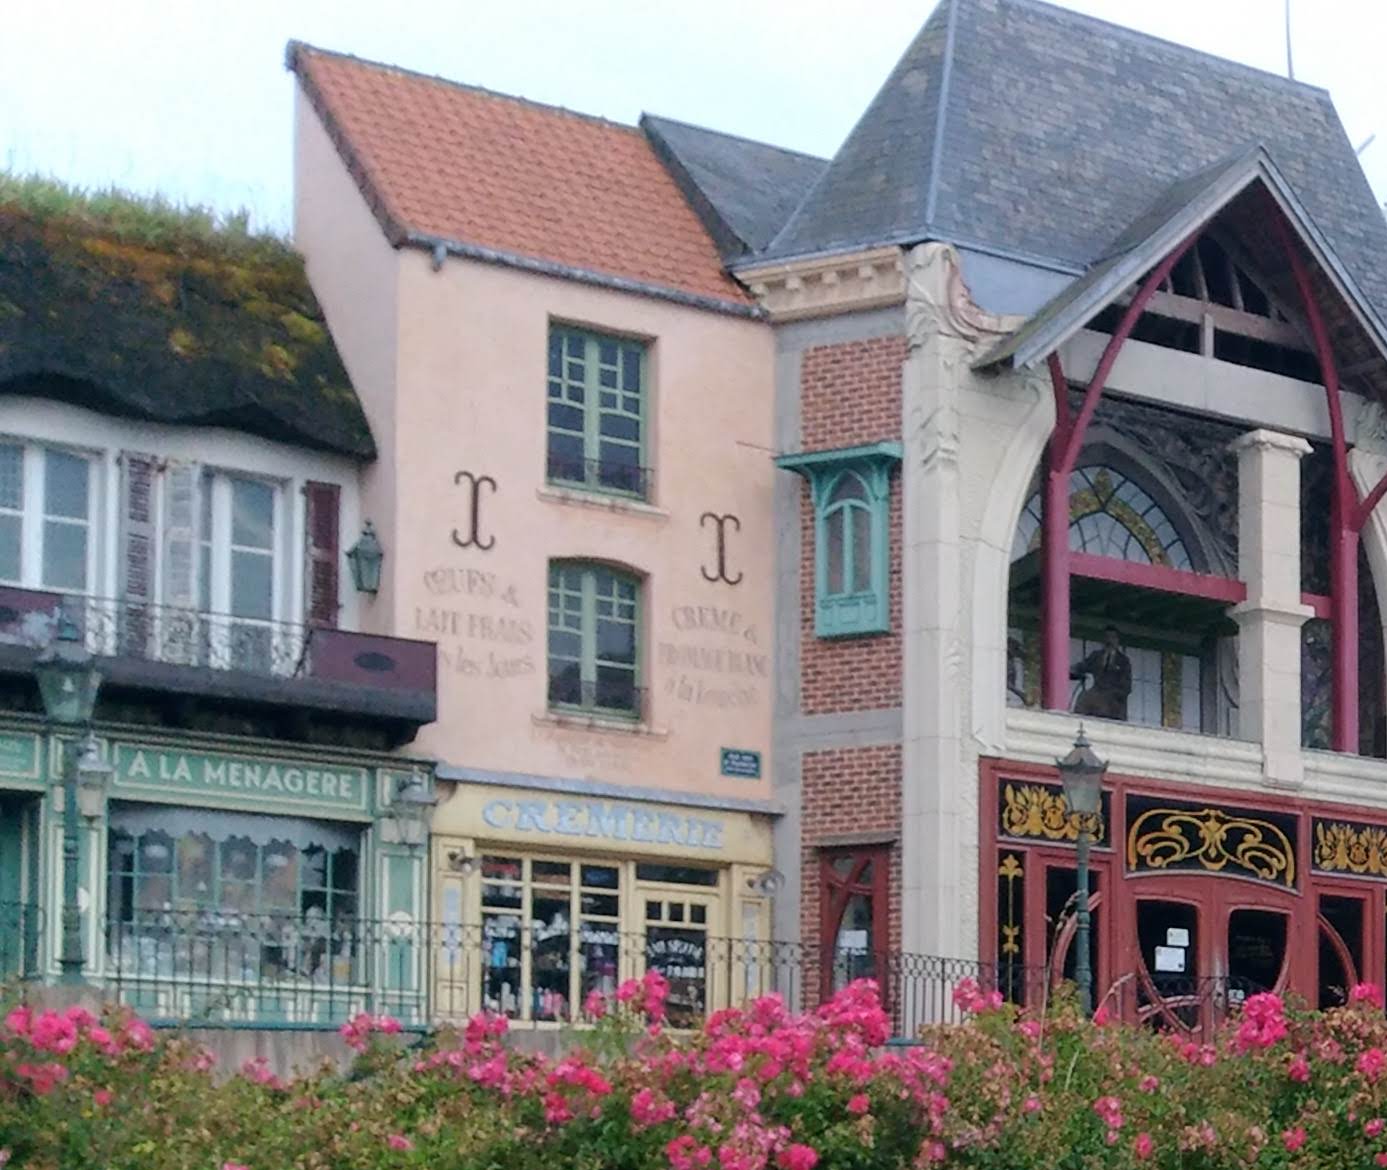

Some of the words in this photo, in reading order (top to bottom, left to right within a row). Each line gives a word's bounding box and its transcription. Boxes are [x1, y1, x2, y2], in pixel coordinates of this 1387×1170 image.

[128, 750, 150, 778] A
[159, 754, 192, 781] LA
[204, 759, 354, 798] MENAGERE
[482, 799, 724, 849] CREMERIE
